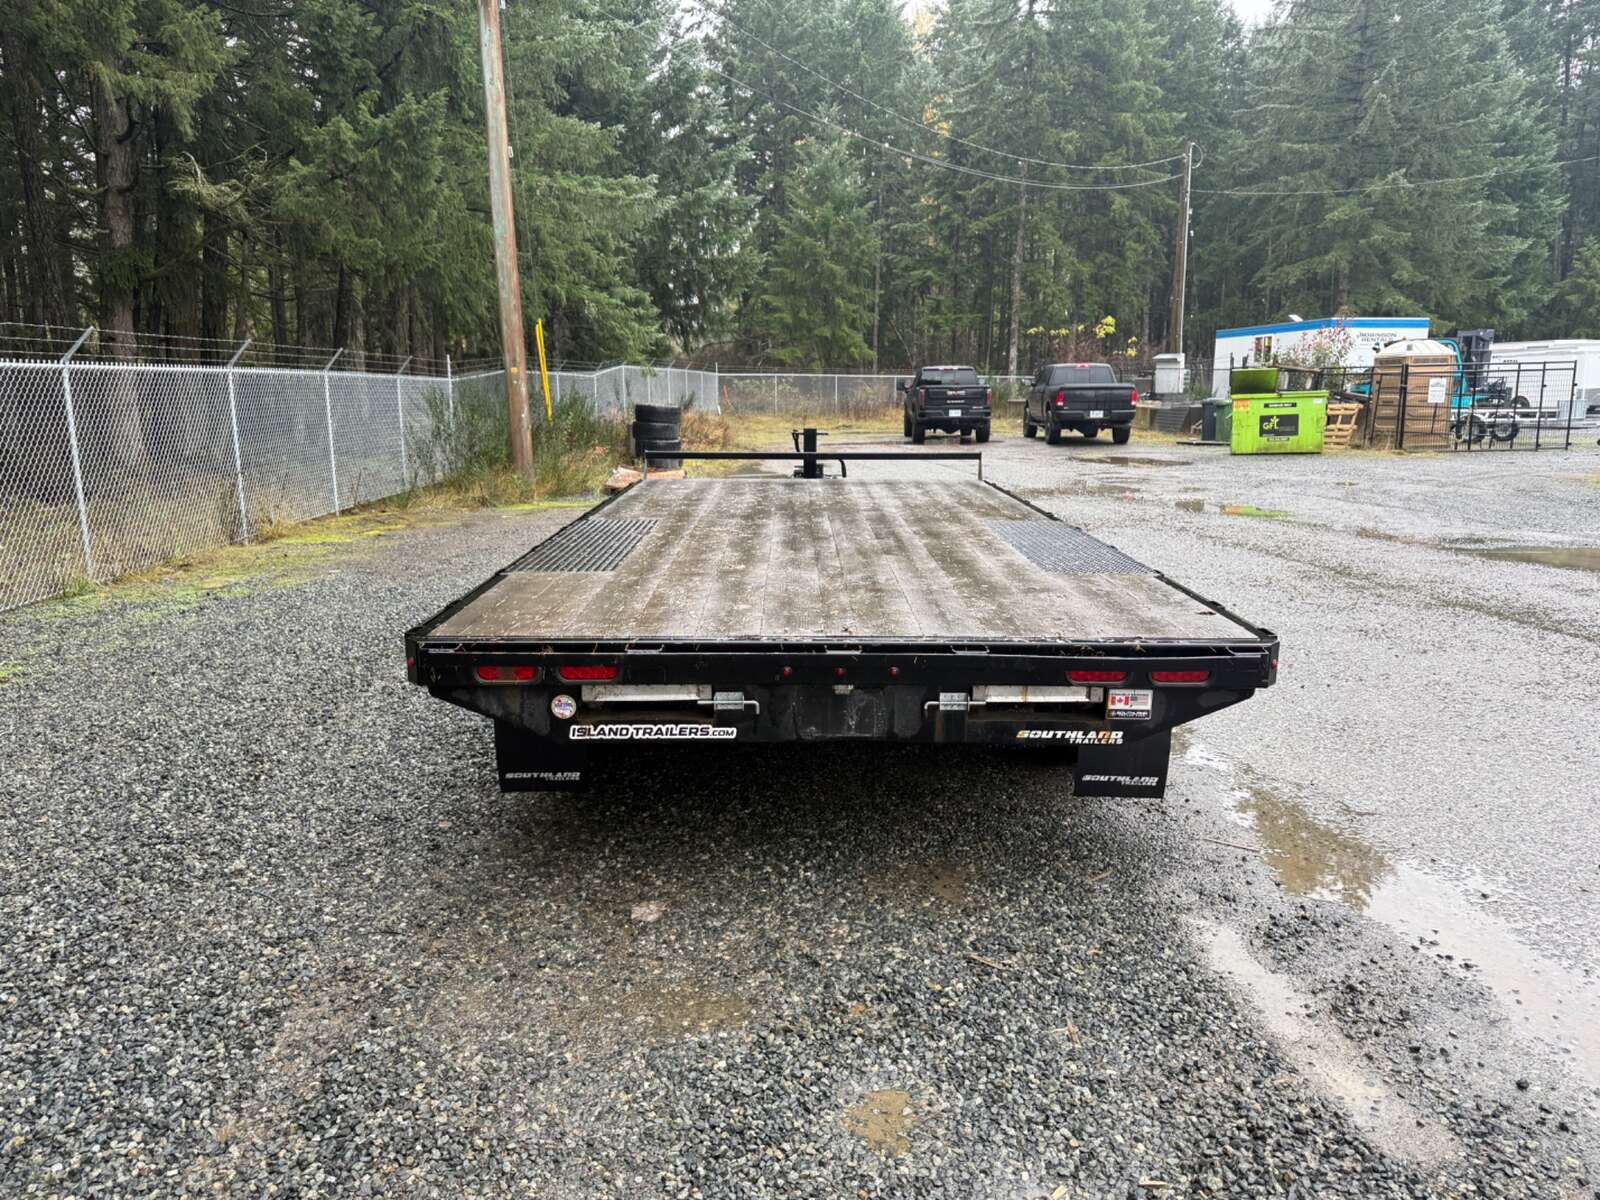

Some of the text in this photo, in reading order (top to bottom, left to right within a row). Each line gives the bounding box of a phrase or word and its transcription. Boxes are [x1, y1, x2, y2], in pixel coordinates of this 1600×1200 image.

[571, 726, 629, 738] ISLAND
[1016, 730, 1124, 739] SOUTHLAND
[505, 771, 580, 779] SOUTHLAND
[1082, 774, 1159, 783] SOUTHLAND
